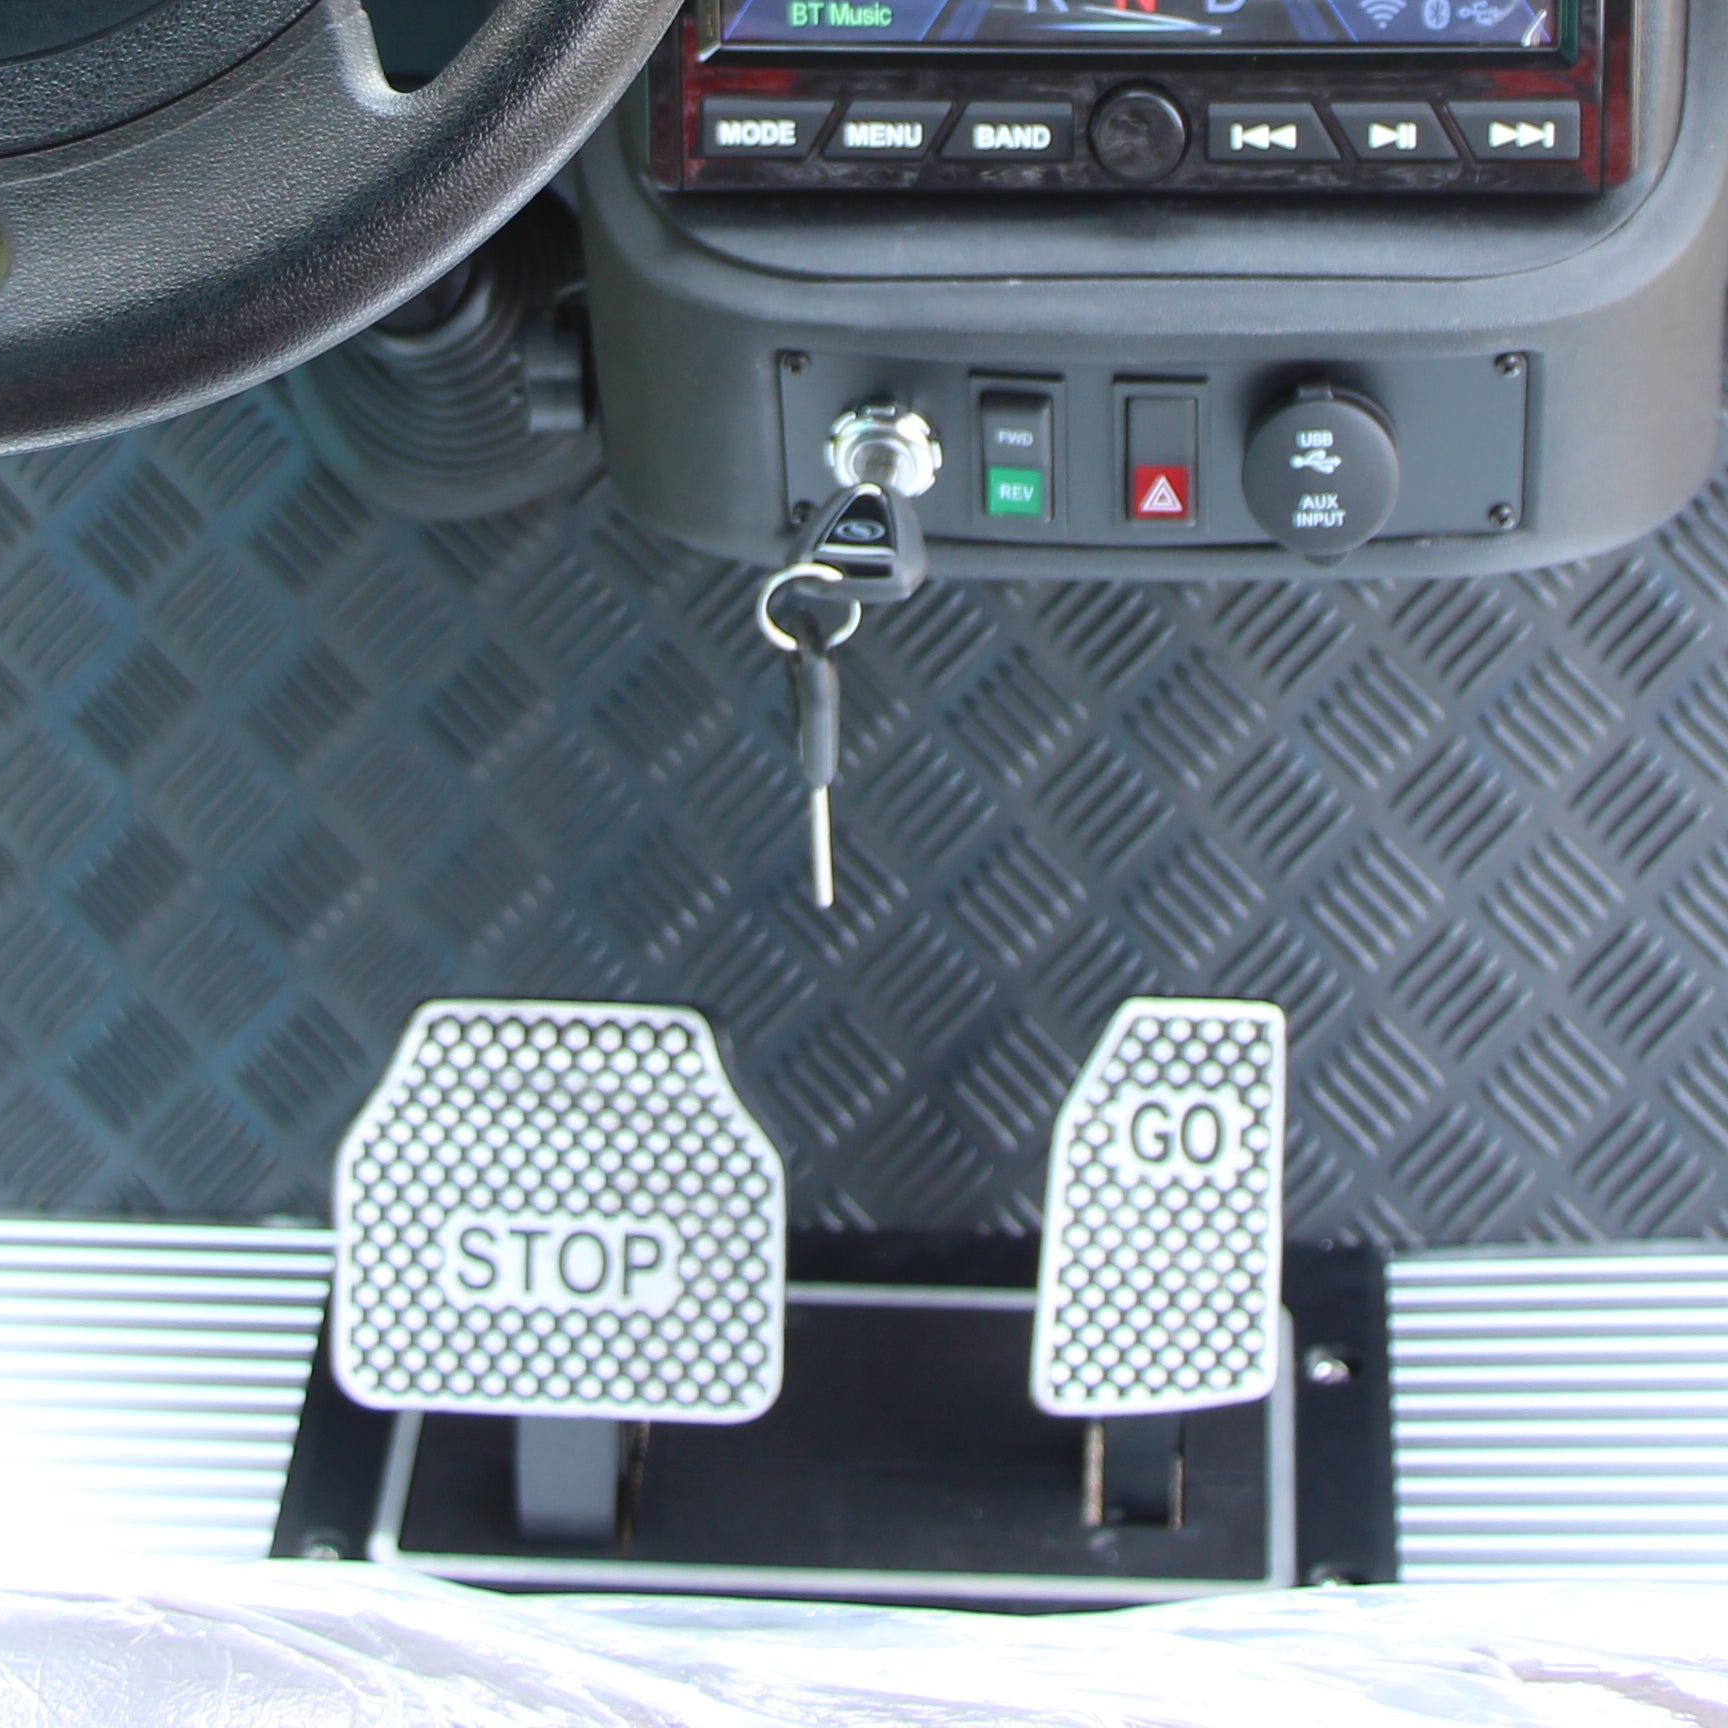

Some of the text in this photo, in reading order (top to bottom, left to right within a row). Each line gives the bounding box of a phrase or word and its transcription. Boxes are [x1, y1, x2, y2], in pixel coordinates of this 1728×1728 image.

[790, 1, 892, 27] BT Music
[716, 120, 797, 147] MODE
[844, 122, 923, 149] MENU
[974, 123, 1051, 151] BAND
[996, 429, 1034, 447] FWD
[998, 483, 1035, 501] REV
[1299, 493, 1339, 510] AUX
[1294, 509, 1346, 528] INPUT
[1130, 1100, 1222, 1165] GO
[458, 1226, 662, 1296] STOP
